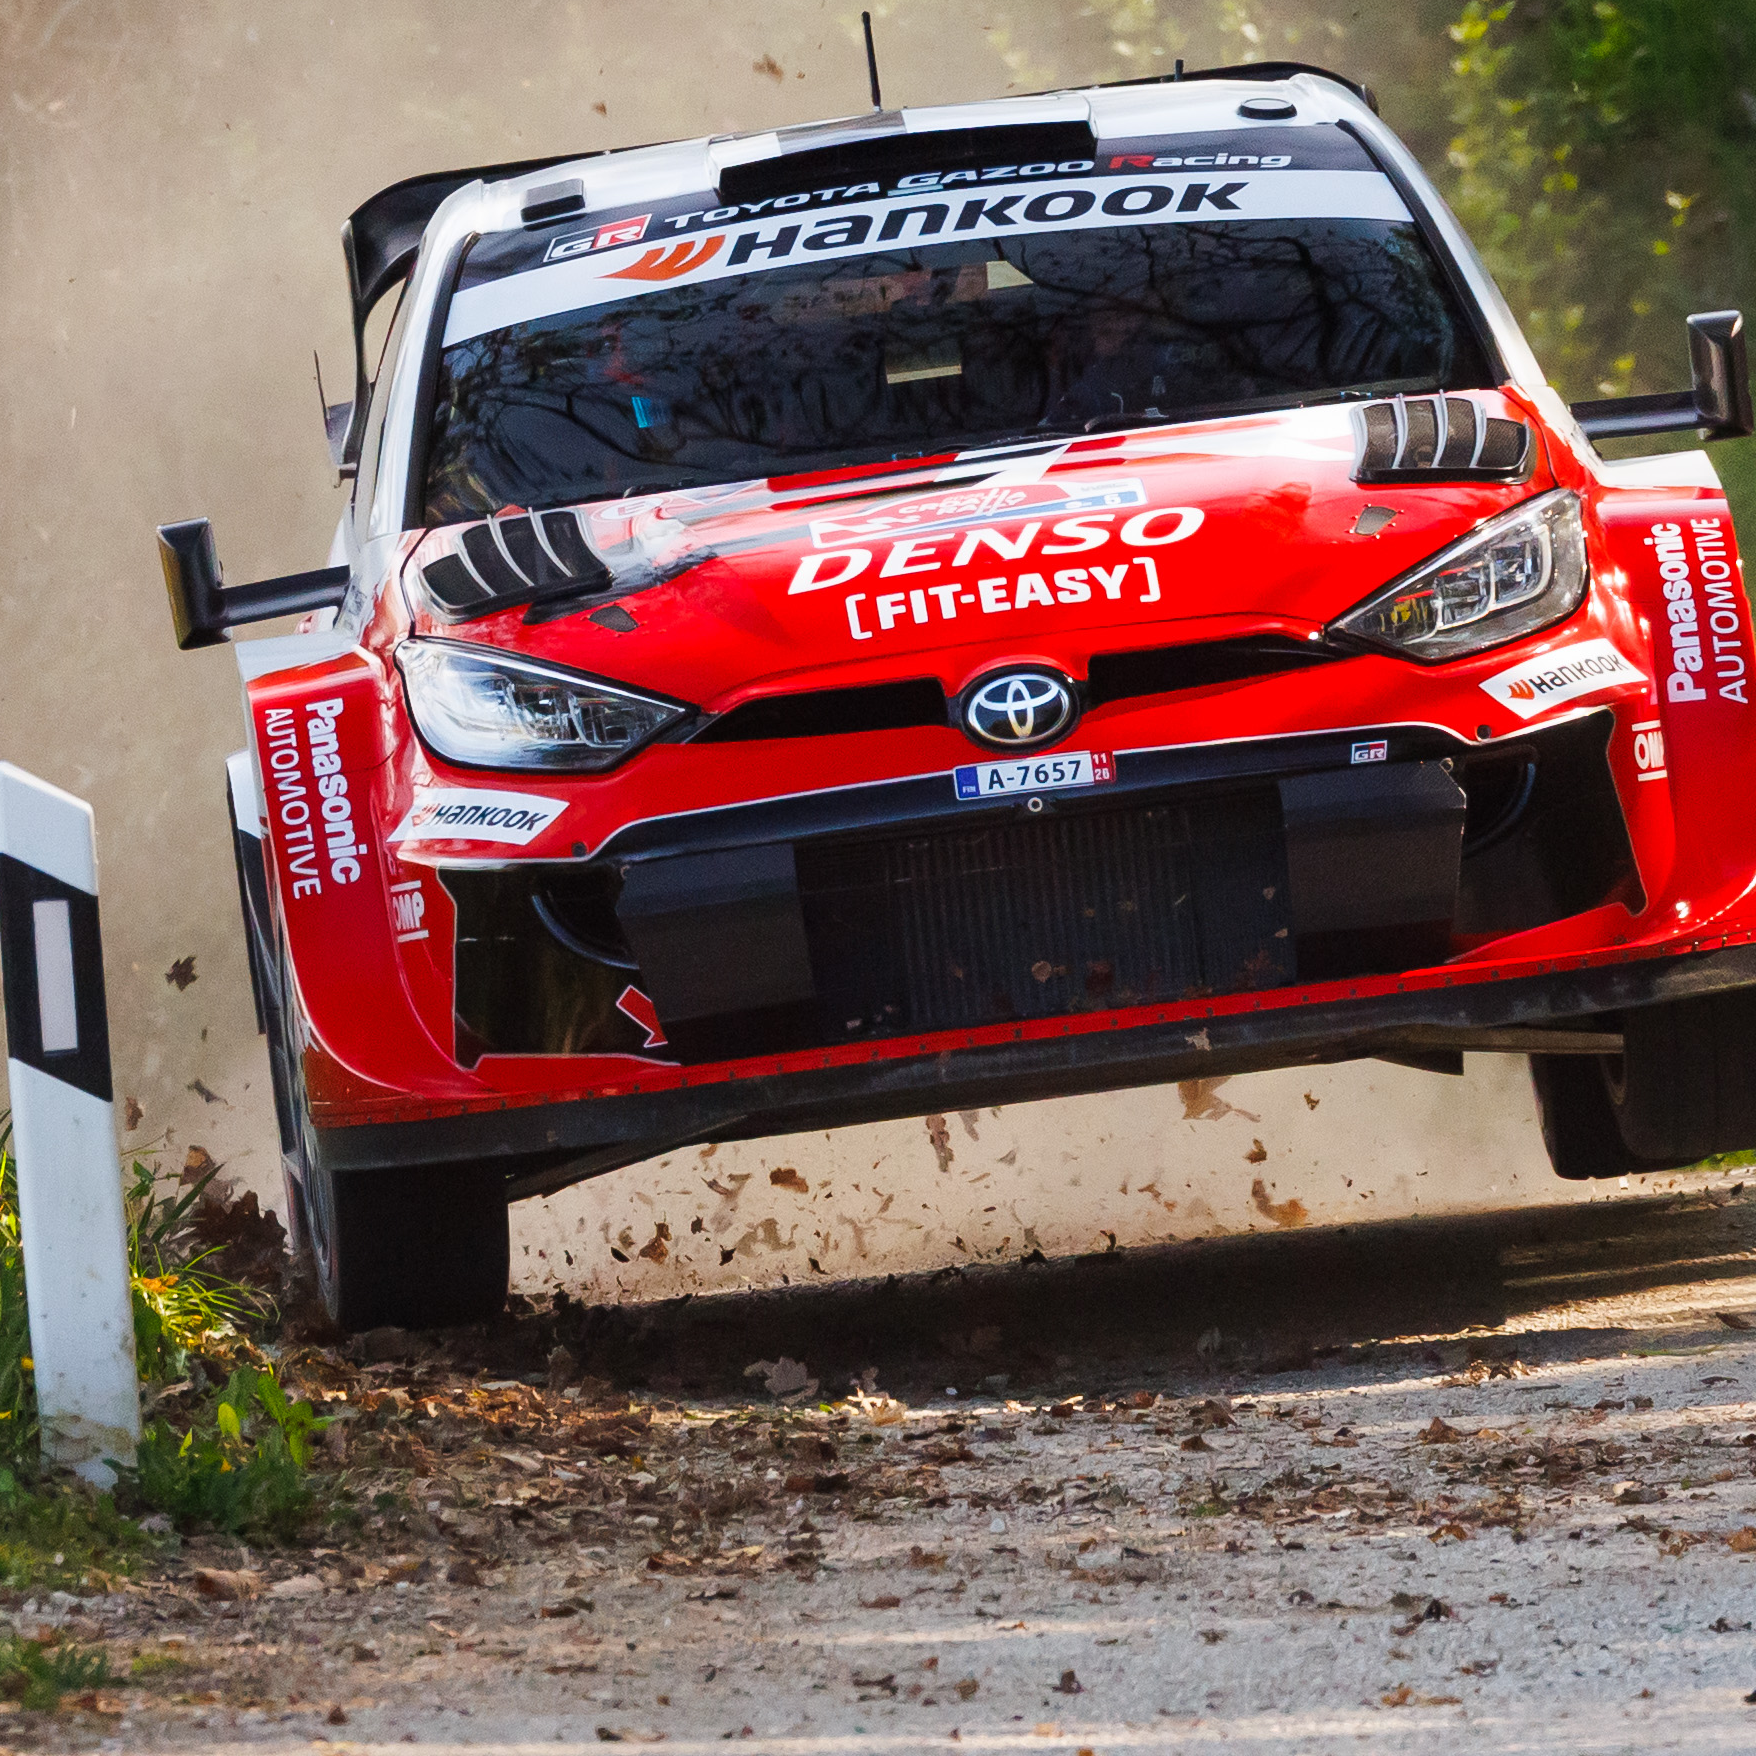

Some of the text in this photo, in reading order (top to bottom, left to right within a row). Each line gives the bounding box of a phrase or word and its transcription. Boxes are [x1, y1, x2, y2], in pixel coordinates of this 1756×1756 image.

[549, 152, 1292, 259] GR TOYOTA GAZOO Racing
[787, 507, 1205, 595] DENSO
[1644, 523, 1706, 703] Panasonic
[1691, 518, 1748, 704] AUTOMOTIVE
[265, 708, 321, 899] AUTOMOTIVE
[306, 698, 367, 884] Panasonic
[988, 760, 1081, 790] A-7657
[1092, 753, 1107, 765] 11
[1354, 748, 1385, 761] GR
